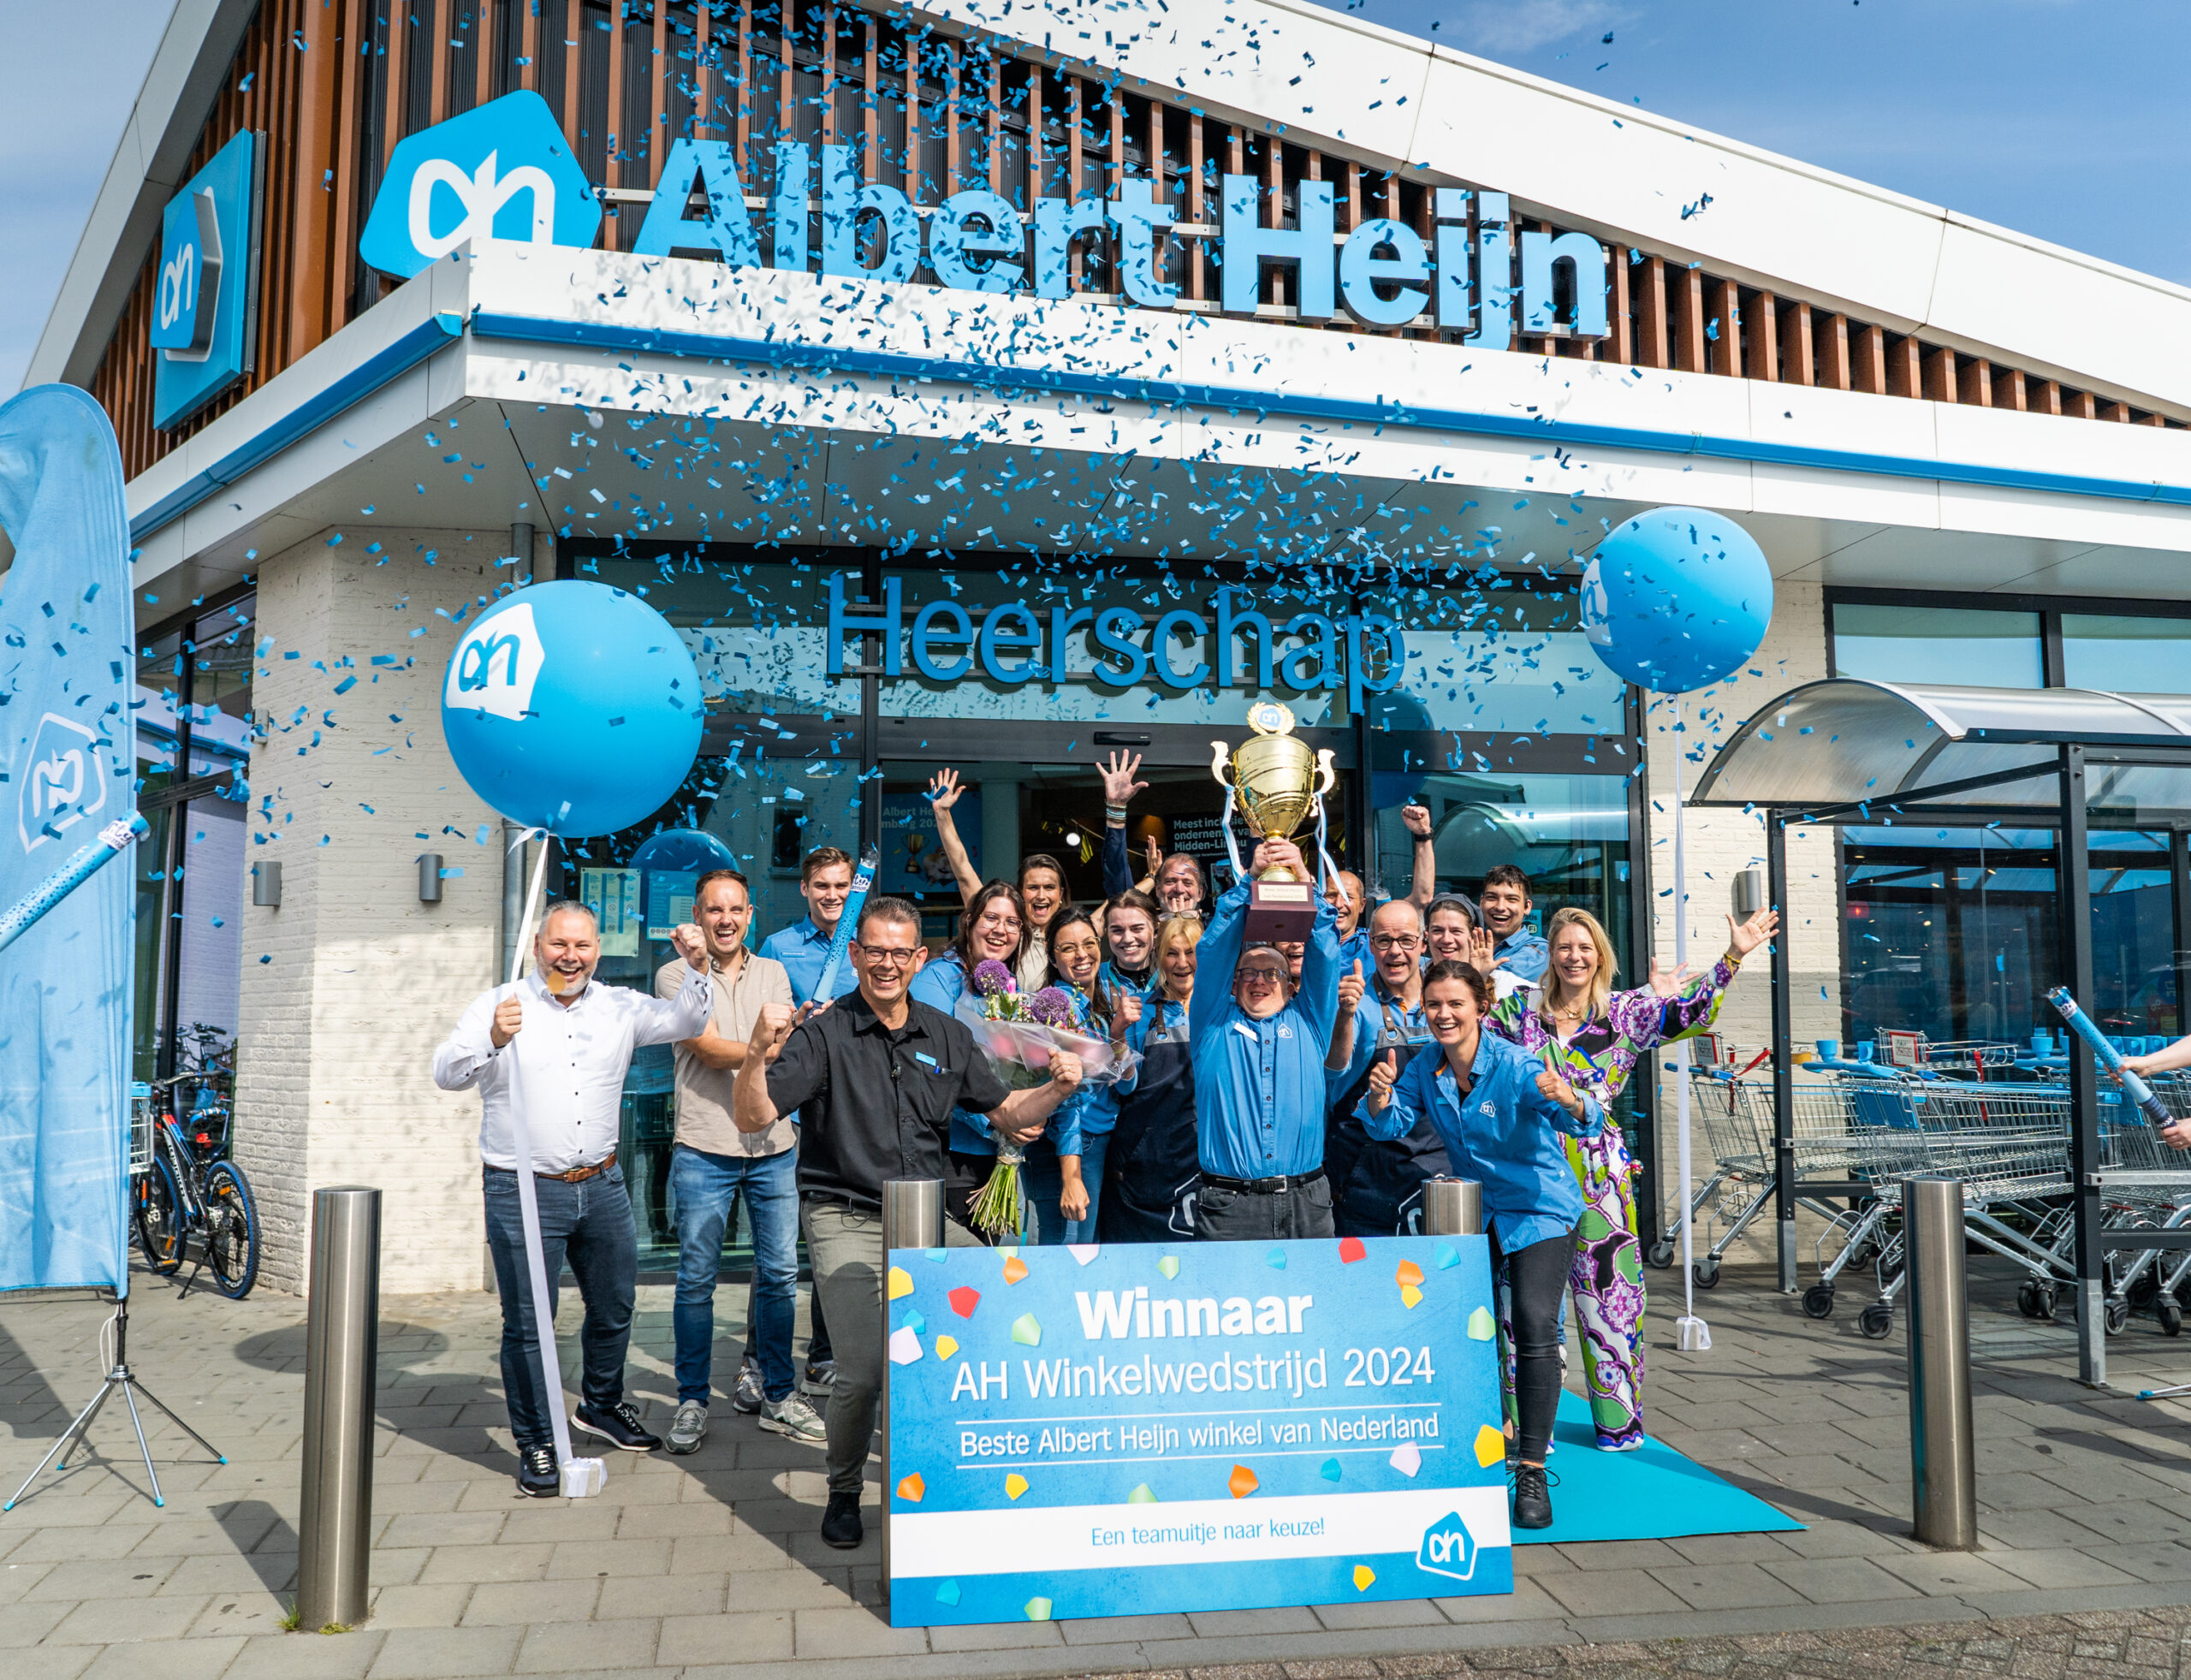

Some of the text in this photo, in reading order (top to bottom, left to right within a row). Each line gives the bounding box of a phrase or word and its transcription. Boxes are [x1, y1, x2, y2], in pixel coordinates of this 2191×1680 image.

[632, 138, 1607, 350] Albert Heijn
[828, 573, 1405, 715] Heerschap
[882, 806, 916, 816] Albert
[1173, 818, 1202, 829] Meest
[1174, 828, 1237, 840] ondernemr
[1075, 1286, 1313, 1340] Winnaar
[951, 1346, 1436, 1402] AH Winkelwedstrijd 2024
[960, 1412, 1440, 1457] Beste Albert Heijn winkel van Nederland
[1091, 1517, 1326, 1546] Een teamuitje naar keuze!
